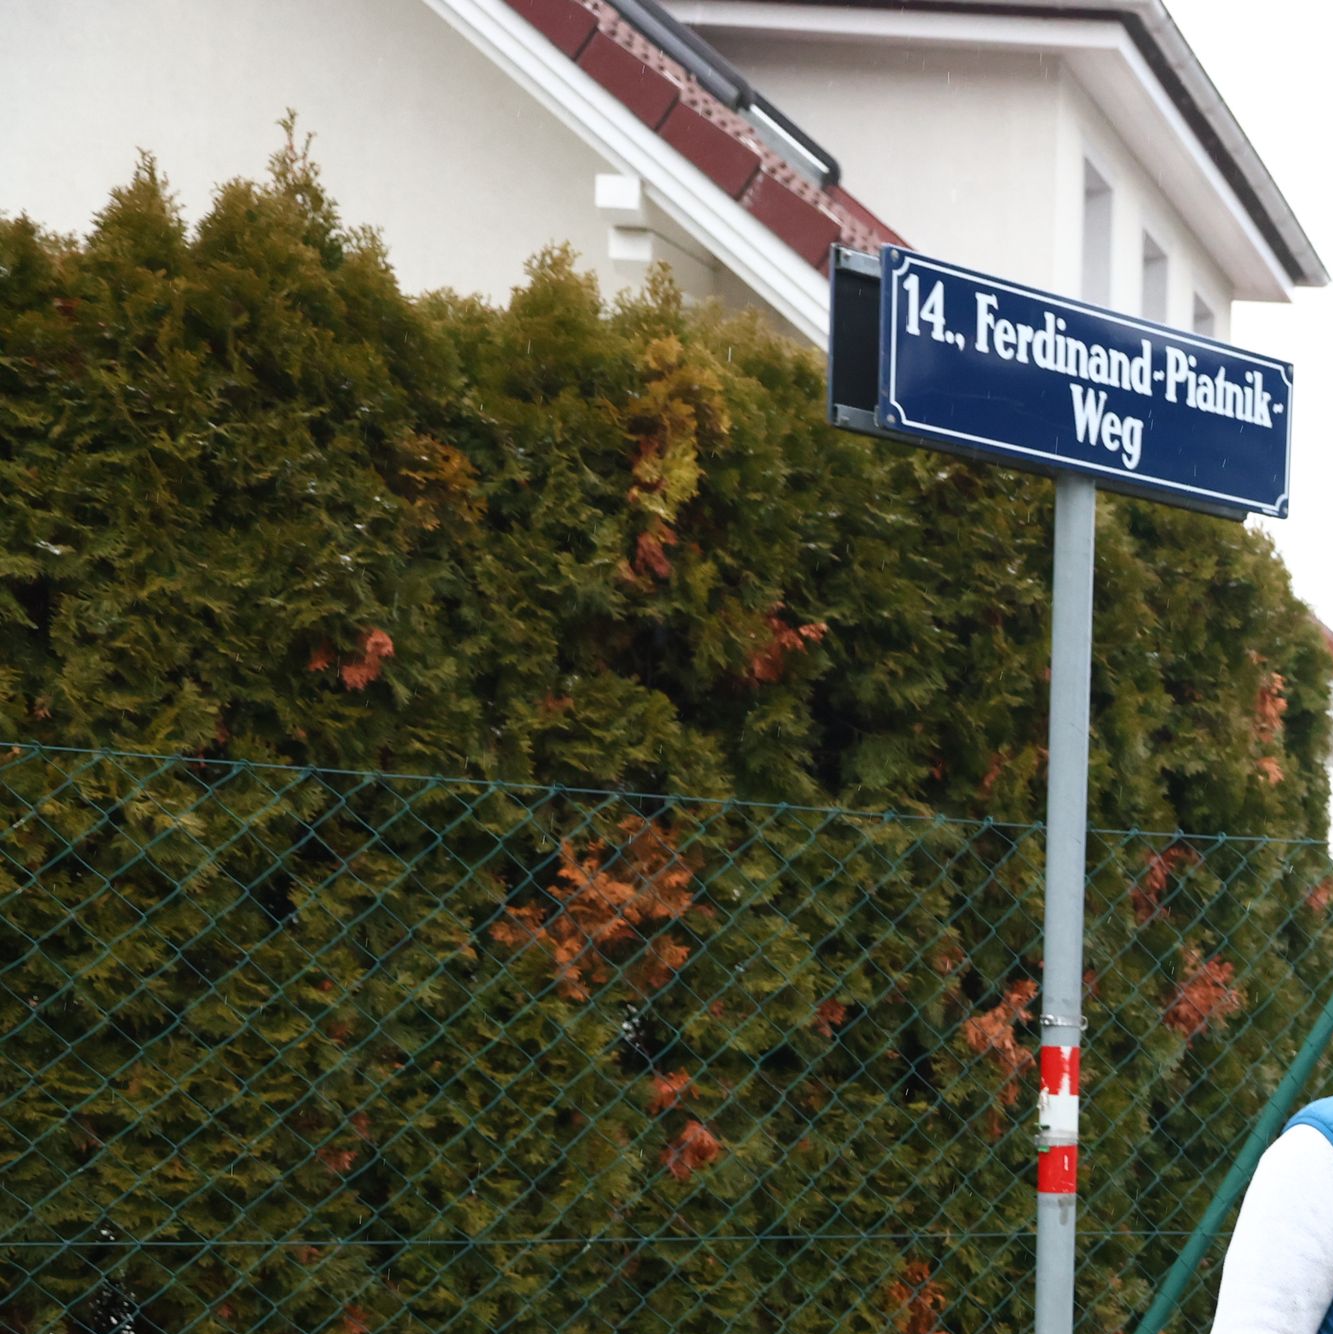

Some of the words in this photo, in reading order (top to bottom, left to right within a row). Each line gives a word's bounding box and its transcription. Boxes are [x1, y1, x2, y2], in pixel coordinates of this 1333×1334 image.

[903, 273, 966, 351] 14.,
[975, 291, 1284, 429] Ferdinand-Piatnik-
[1070, 383, 1144, 470] Weg
